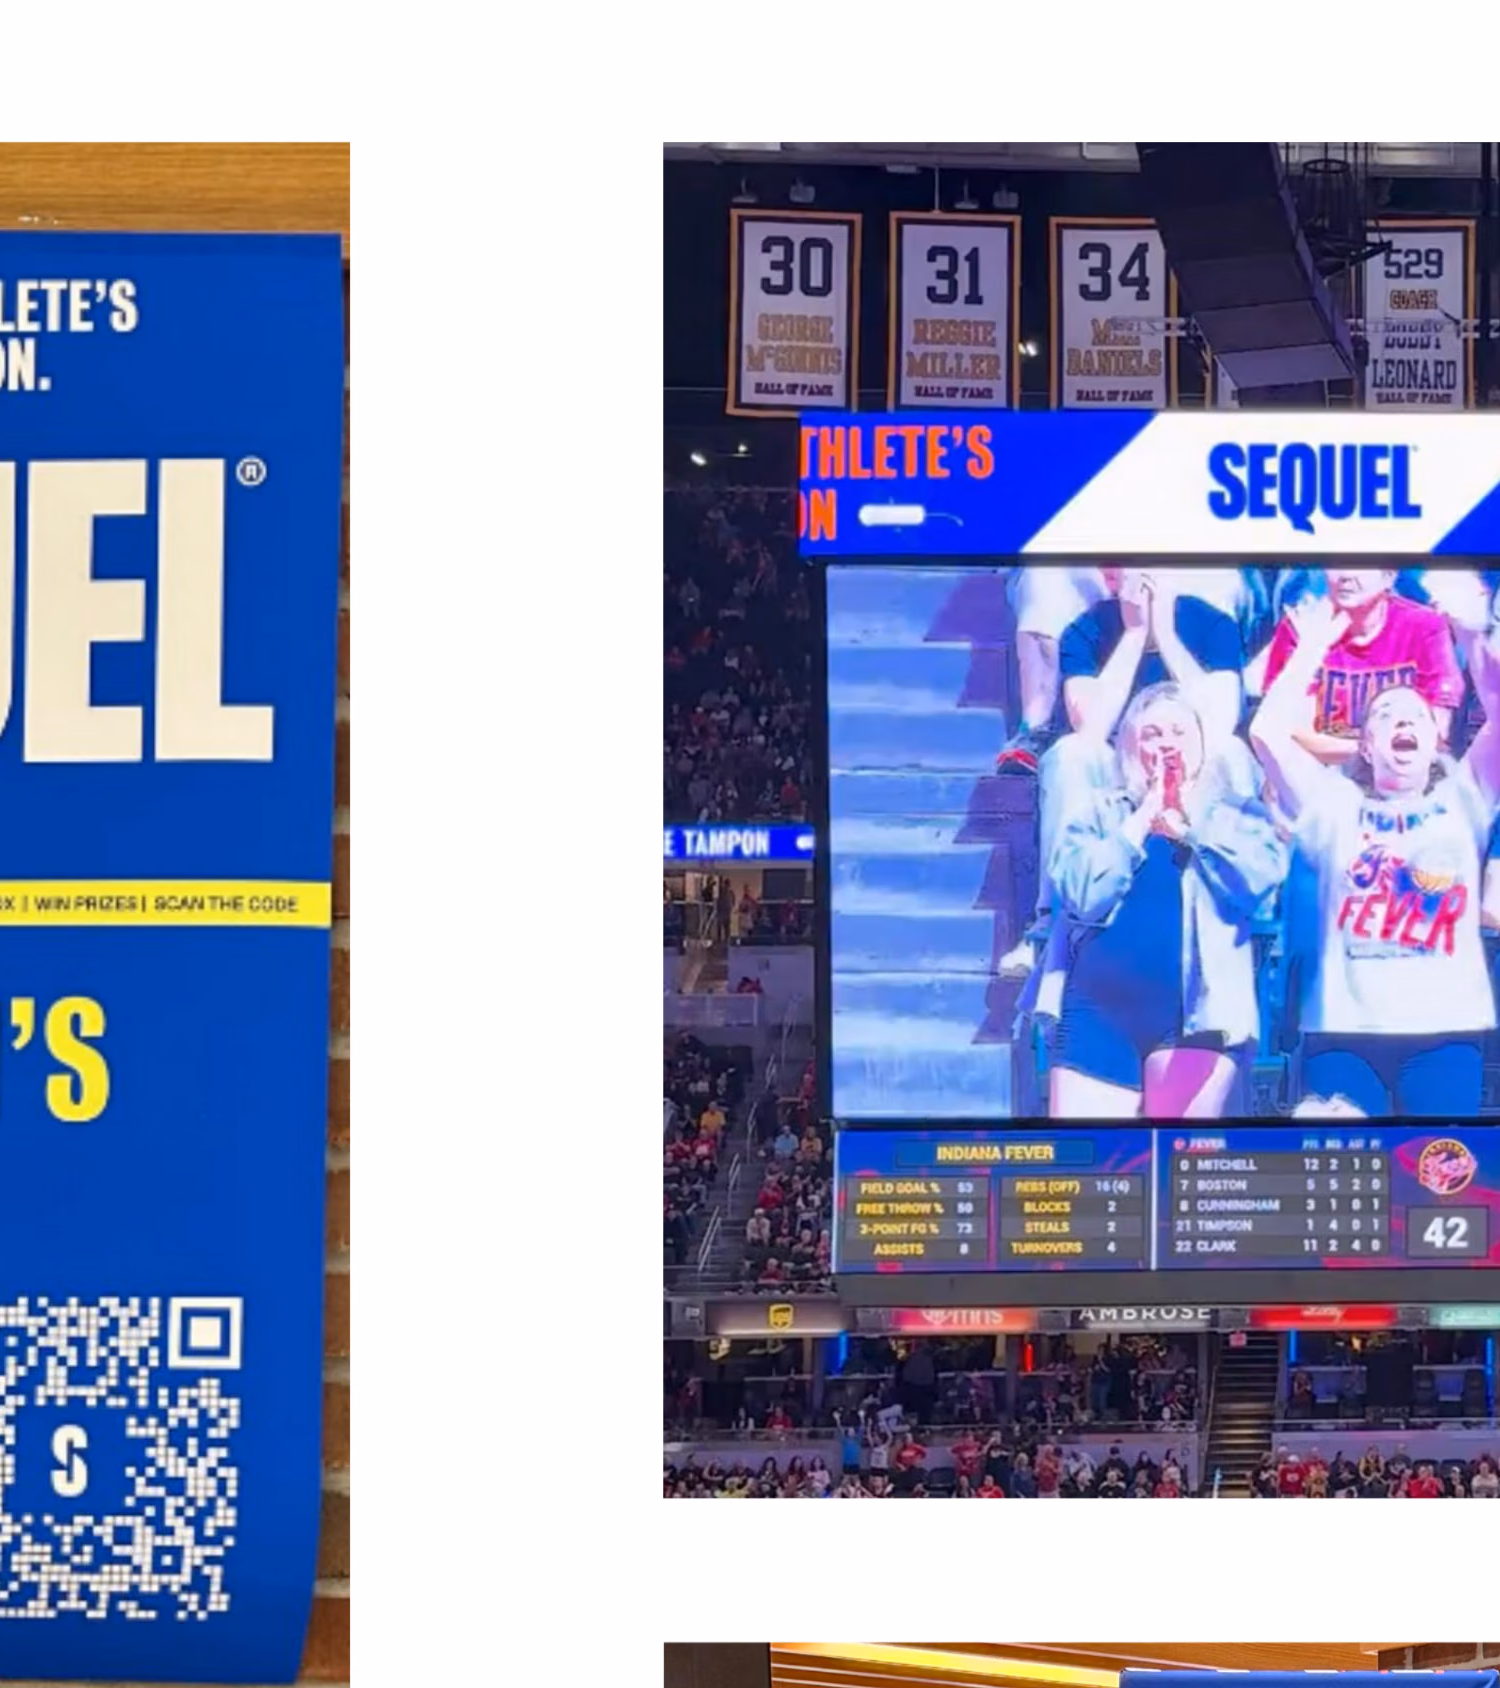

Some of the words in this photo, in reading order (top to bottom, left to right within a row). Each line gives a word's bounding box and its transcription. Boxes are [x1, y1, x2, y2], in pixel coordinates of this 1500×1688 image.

[760, 236, 833, 297] 30
[926, 245, 983, 305] 31
[1079, 243, 1150, 301] 34
[1384, 249, 1443, 279] 529
[1390, 289, 1438, 310] COACH
[913, 319, 996, 346] REGGIE
[906, 351, 1001, 379] MILLER
[1067, 348, 1162, 377] DANIELS
[1371, 358, 1456, 390] LEONARD
[1208, 443, 1421, 534] SEQUEL
[683, 829, 770, 857] TAMPON
[34, 895, 70, 912] WIN
[74, 895, 137, 912] PRIZES
[154, 895, 205, 912] SCAN
[210, 895, 244, 913] THE
[249, 895, 299, 913] CODE
[1337, 884, 1468, 957] FEVER
[937, 1145, 1001, 1161] INDIANA
[1004, 1145, 1054, 1161] FEVER
[1197, 1158, 1257, 1172] MITCHELL
[1197, 1240, 1237, 1254] CLARK
[1424, 1217, 1468, 1249] 42
